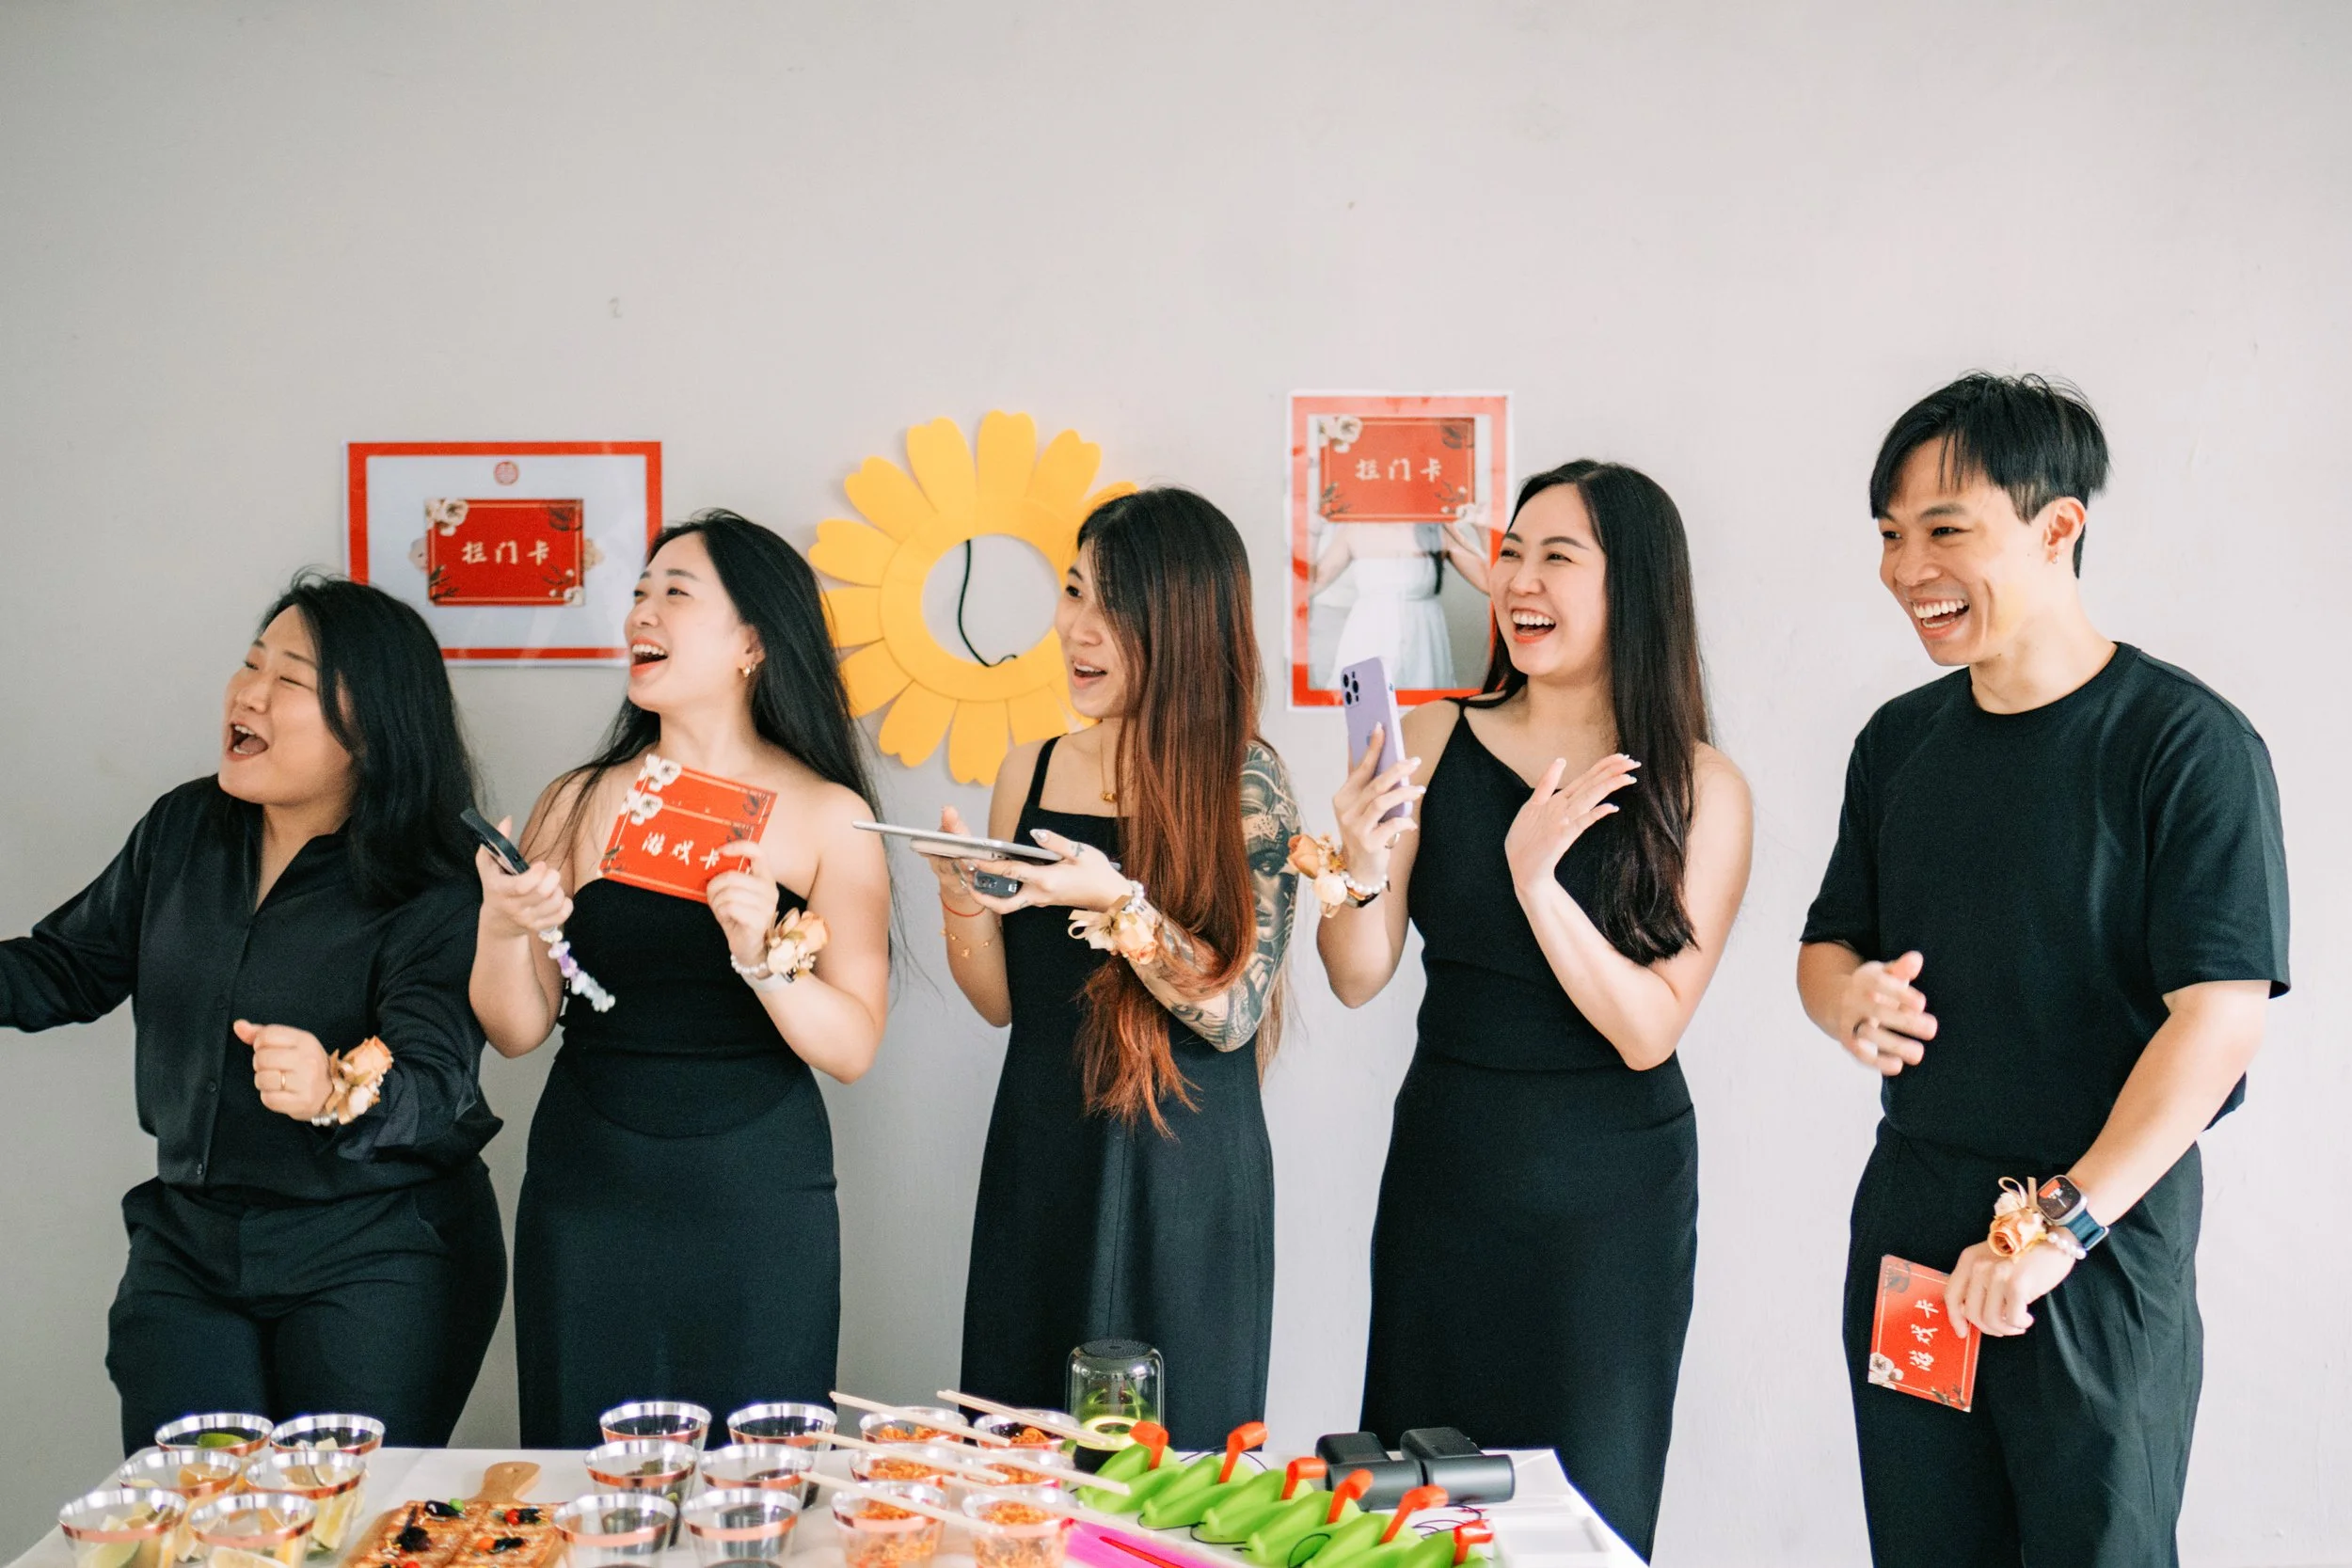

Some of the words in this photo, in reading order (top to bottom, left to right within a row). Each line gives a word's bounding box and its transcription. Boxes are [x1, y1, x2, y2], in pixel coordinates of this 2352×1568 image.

[641, 831, 721, 870] 游戏卡
[1908, 1299, 1939, 1371] 游戏卡
